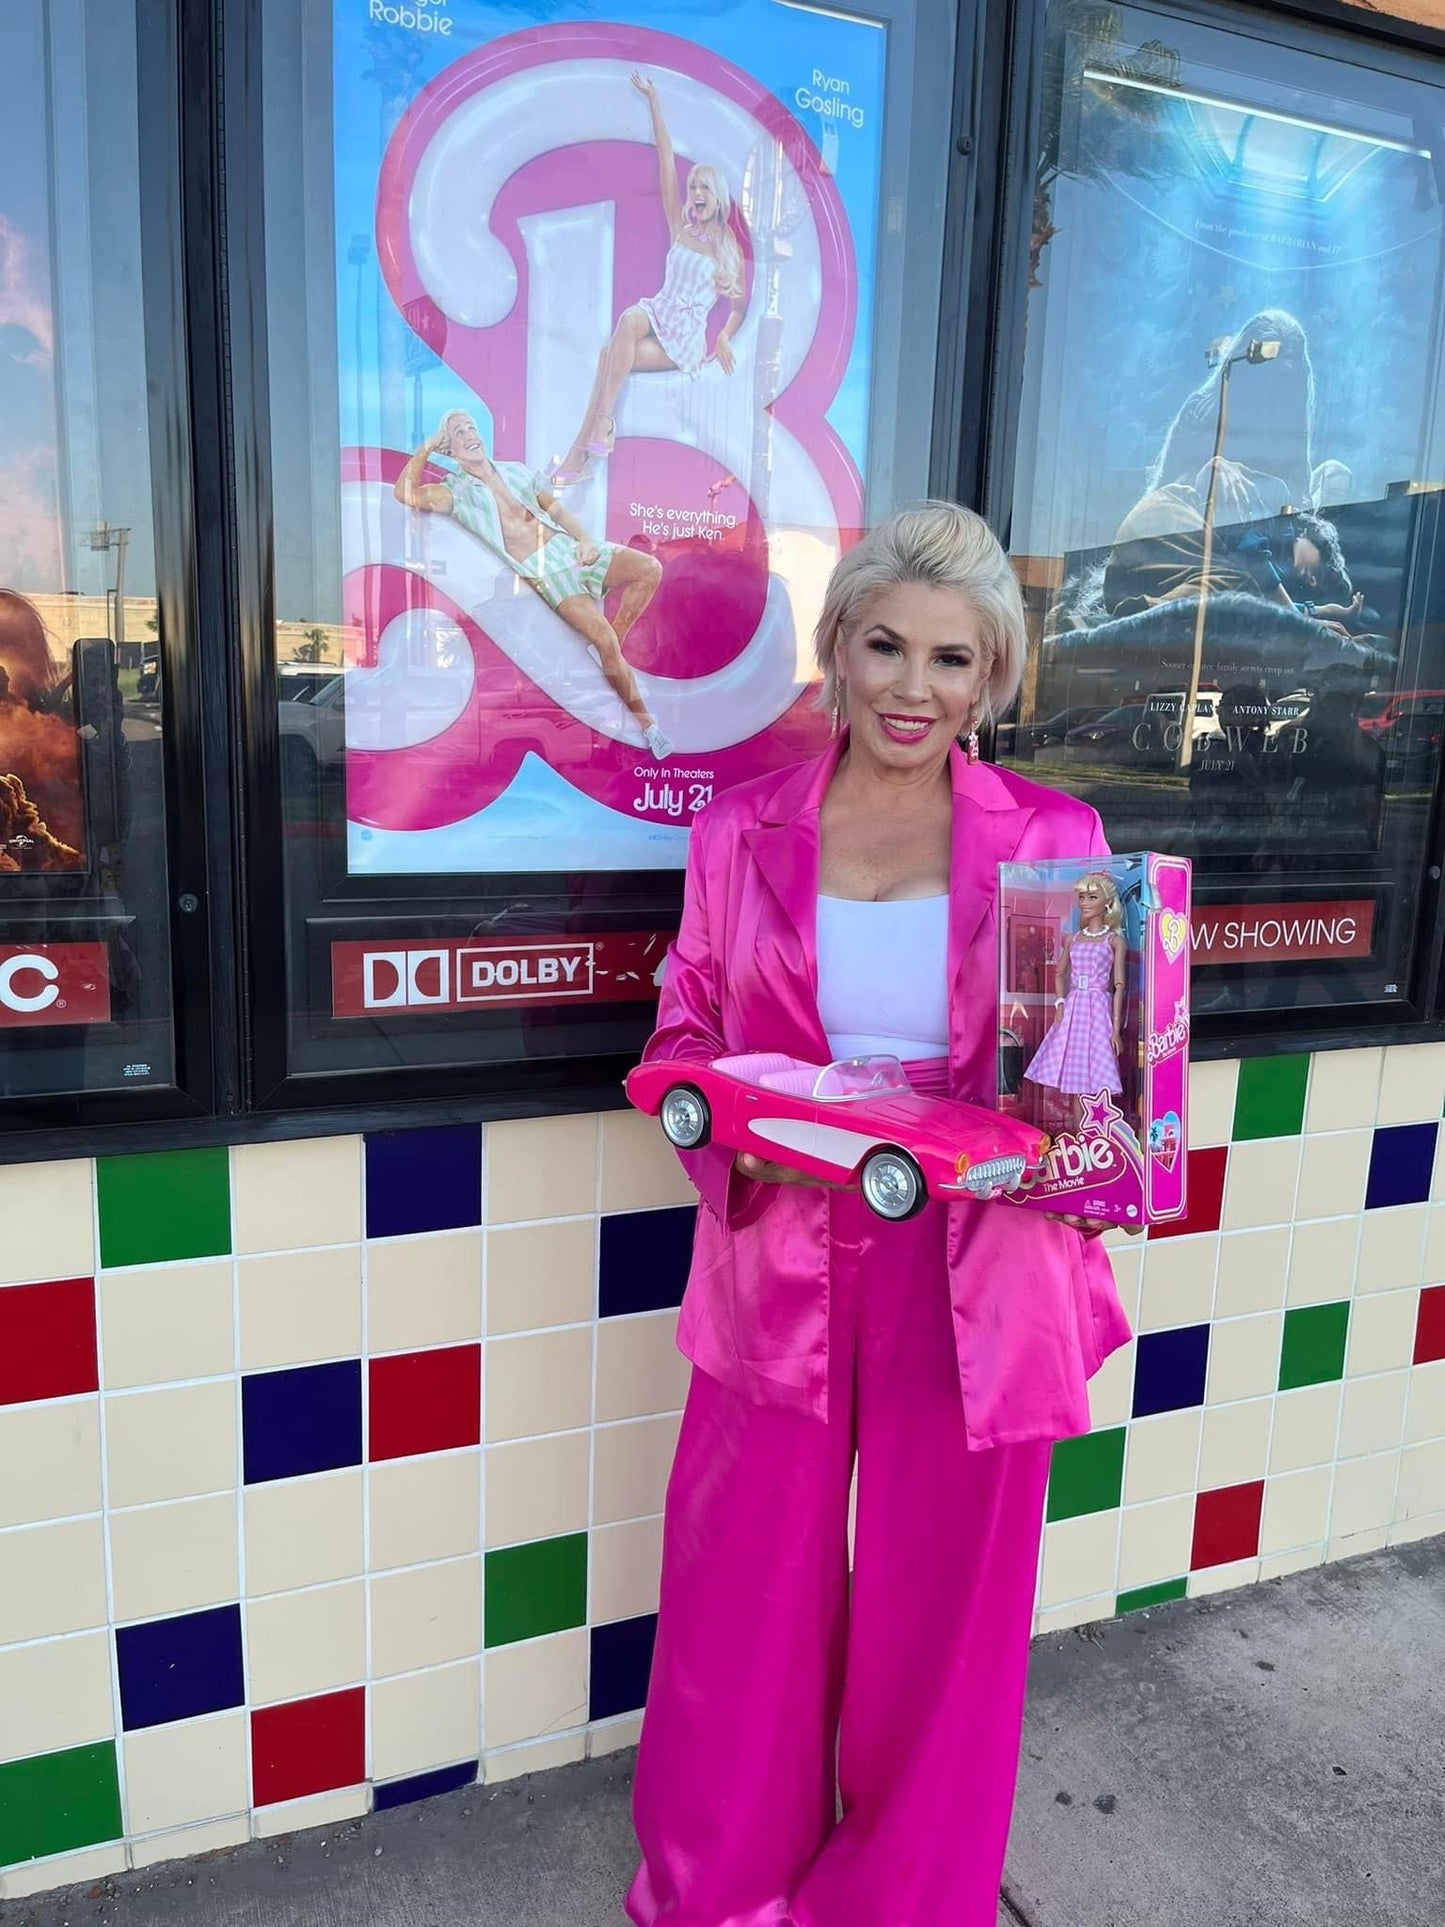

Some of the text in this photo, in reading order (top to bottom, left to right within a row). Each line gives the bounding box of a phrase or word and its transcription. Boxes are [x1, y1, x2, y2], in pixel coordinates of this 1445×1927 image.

[369, 0, 453, 35] Robbie
[812, 68, 850, 94] Ryan
[795, 87, 864, 128] Gosling
[630, 502, 739, 528] She's everything.
[643, 520, 725, 541] He's just Ken.
[1150, 701, 1177, 712] LIZZY
[1232, 705, 1300, 716] ANTONY STARR
[1132, 722, 1308, 754] COBWEB
[633, 766, 715, 780] Only In Theaters
[1199, 759, 1236, 772] JULY 21
[633, 782, 713, 817] July 21
[1223, 917, 1356, 949] SHOWING
[471, 956, 582, 988] DOLBY
[1147, 1023, 1186, 1062] Barbie
[1018, 1135, 1115, 1190] arbie
[1043, 1176, 1085, 1193] The Movie
